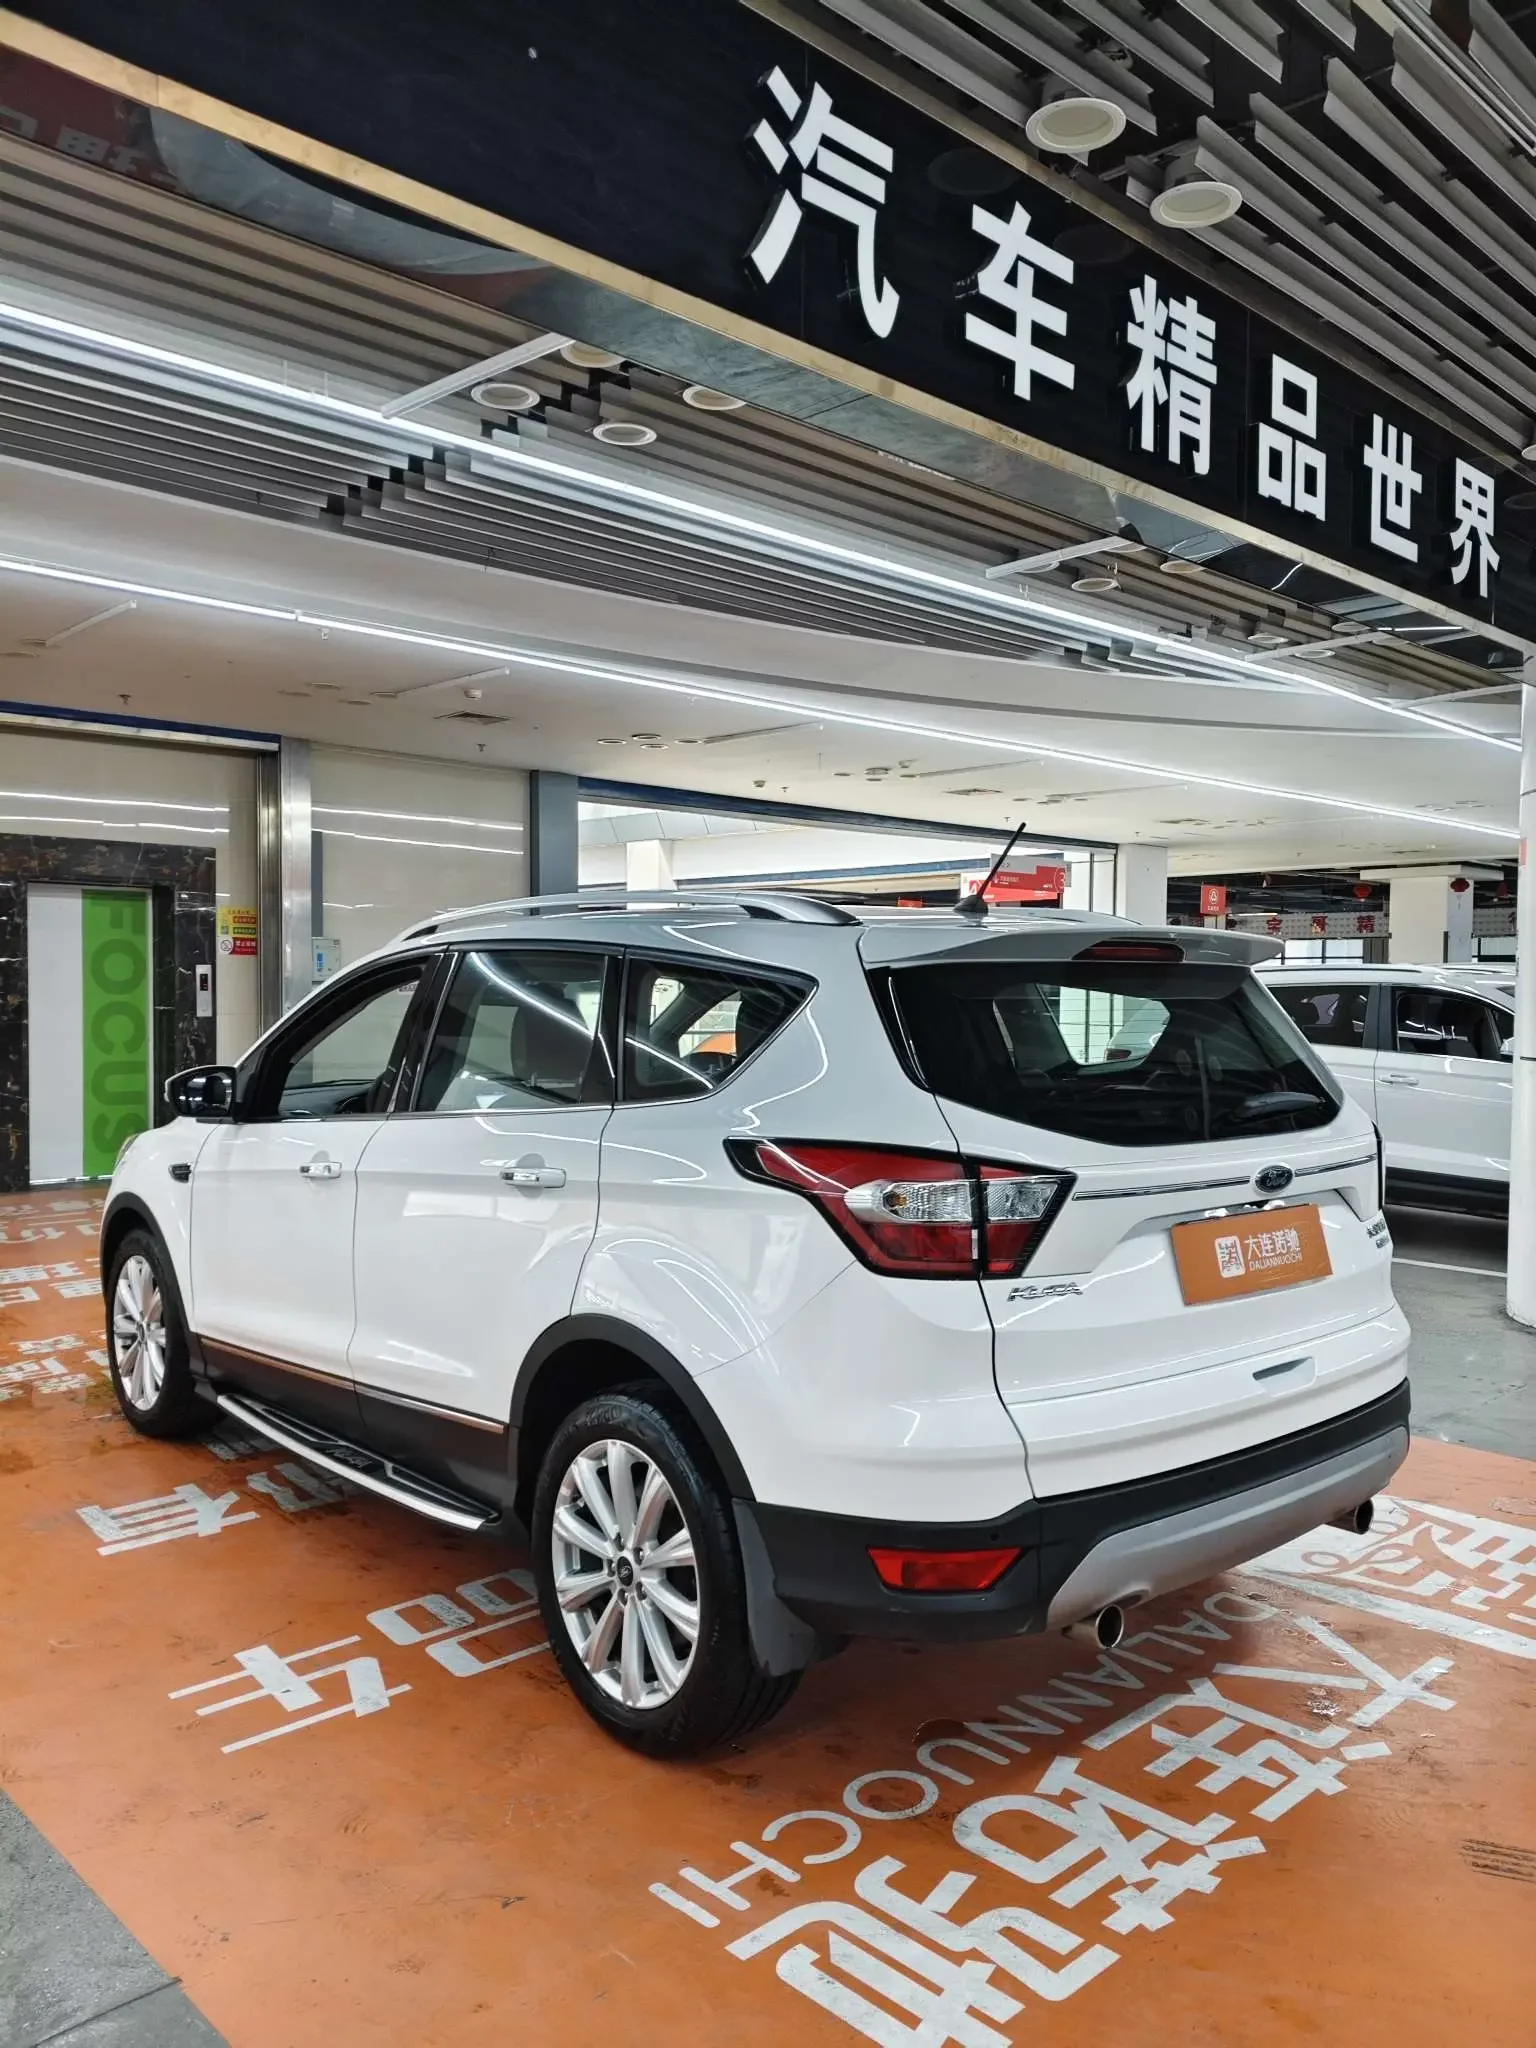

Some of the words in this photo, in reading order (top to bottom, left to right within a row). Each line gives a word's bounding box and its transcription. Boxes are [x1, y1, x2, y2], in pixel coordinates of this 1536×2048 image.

[750, 65, 1501, 599] 汽车精品世界
[90, 889, 147, 1154] FOCUS
[1244, 1227, 1302, 1260] 大连诺驰
[1249, 1251, 1303, 1272] DALIANNUOCHI
[724, 1615, 1457, 2048] 大连诺驰
